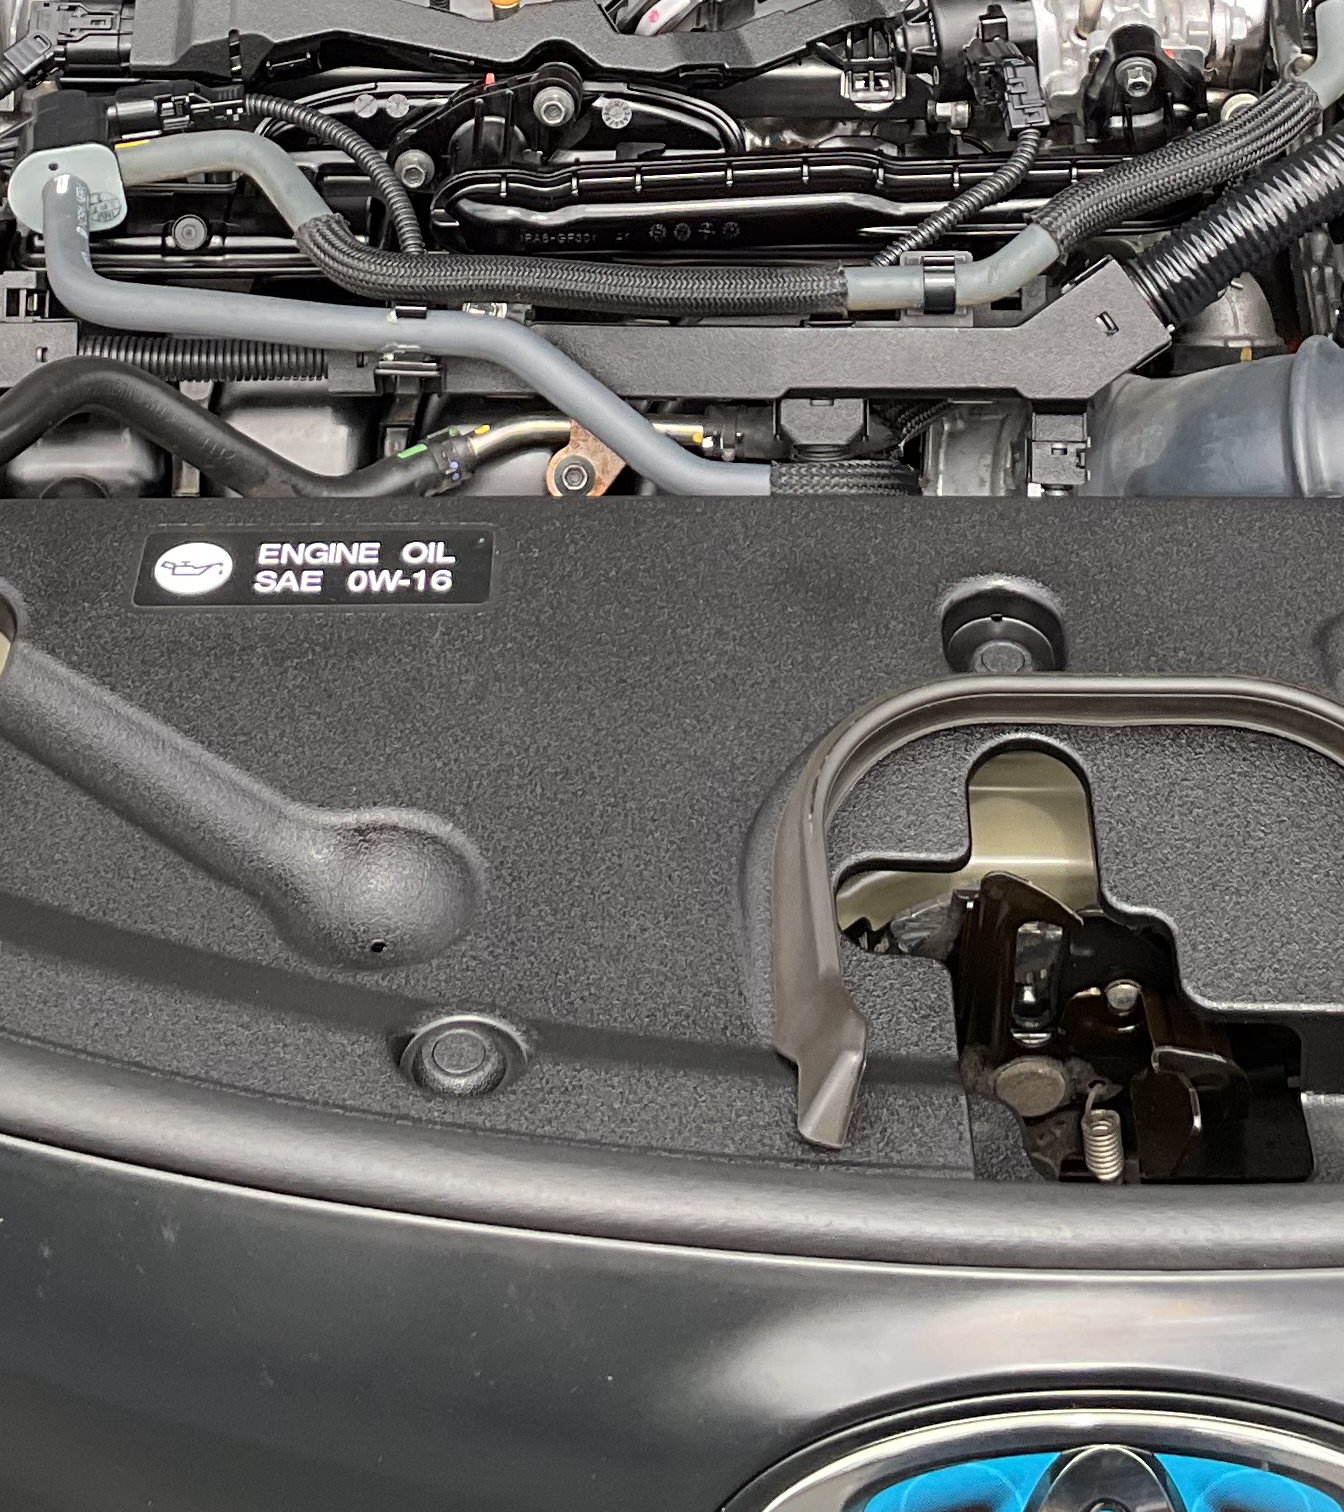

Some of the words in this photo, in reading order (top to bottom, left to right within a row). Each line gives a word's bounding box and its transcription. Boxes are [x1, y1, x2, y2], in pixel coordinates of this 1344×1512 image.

[257, 541, 382, 565] ENGINE
[401, 541, 456, 565] OIL
[253, 569, 324, 594] SAE
[346, 569, 454, 593] 0W-16
